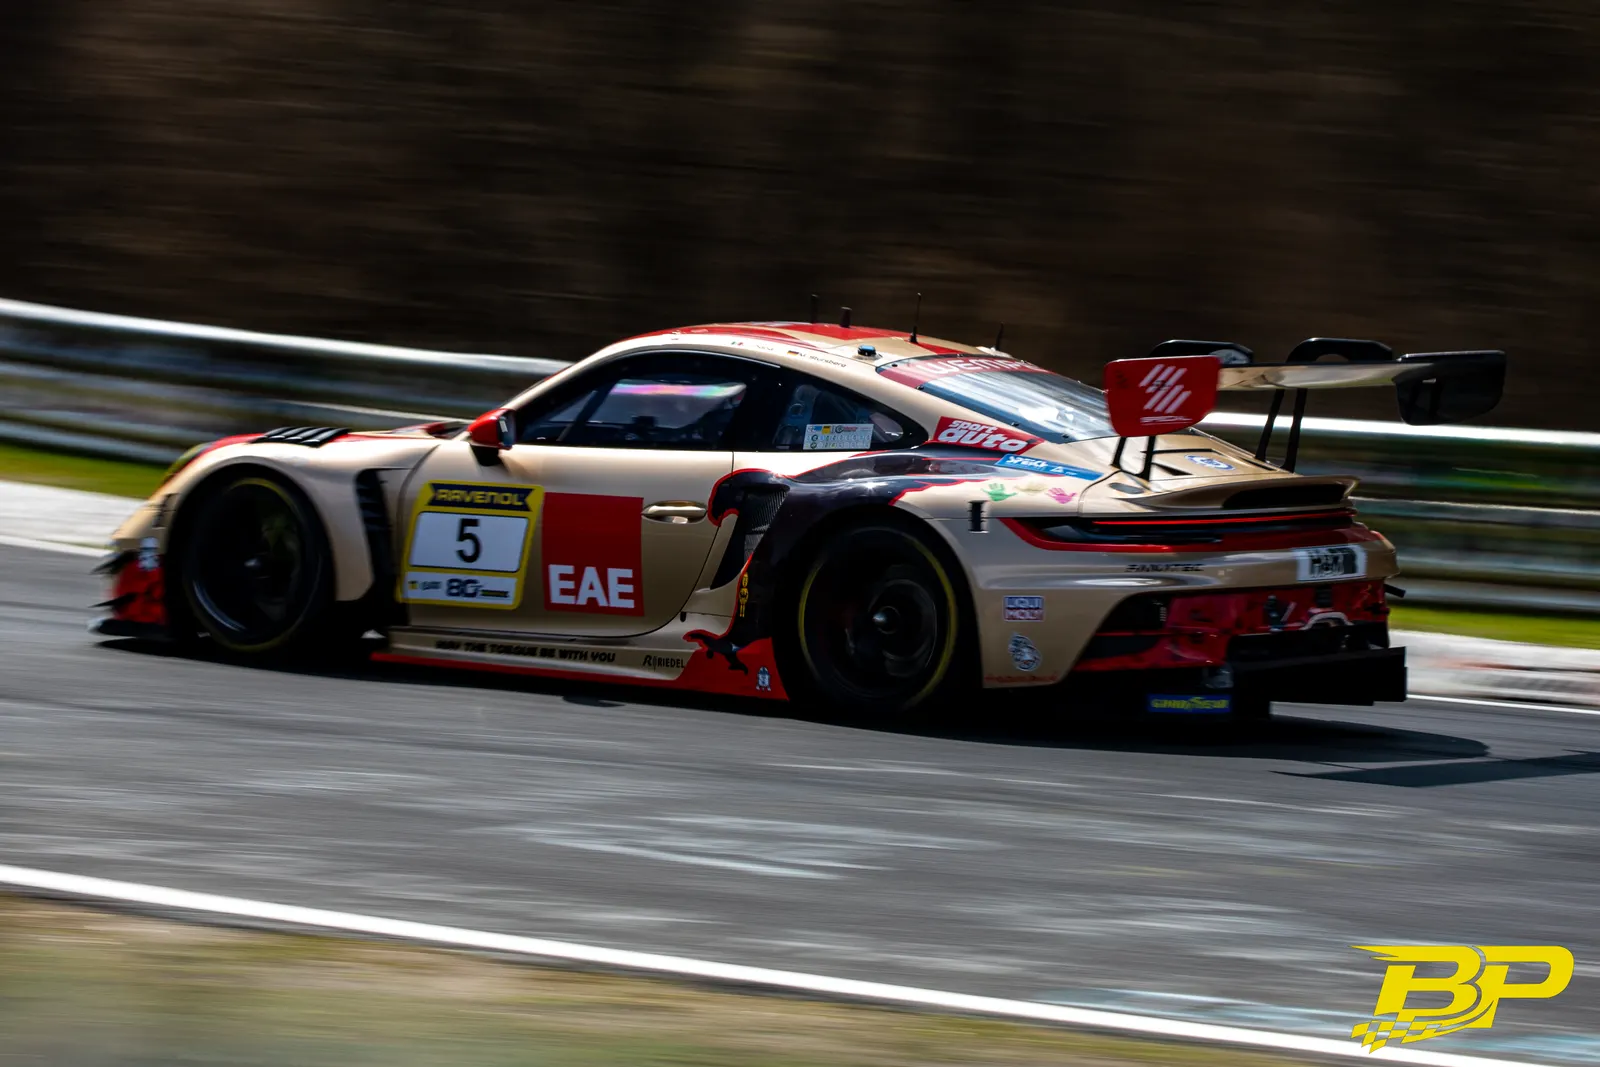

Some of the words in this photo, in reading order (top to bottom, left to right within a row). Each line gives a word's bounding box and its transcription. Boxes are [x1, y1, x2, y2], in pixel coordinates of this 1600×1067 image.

[948, 420, 998, 434] sport
[938, 427, 1028, 452] auto
[434, 488, 525, 506] RAVENOL
[456, 518, 482, 563] 5
[548, 564, 635, 609] EAE
[464, 642, 487, 652] THE
[539, 648, 555, 657] BE
[558, 649, 588, 660] WITH
[591, 652, 616, 663] YOU
[657, 657, 685, 668] RIEDEL
